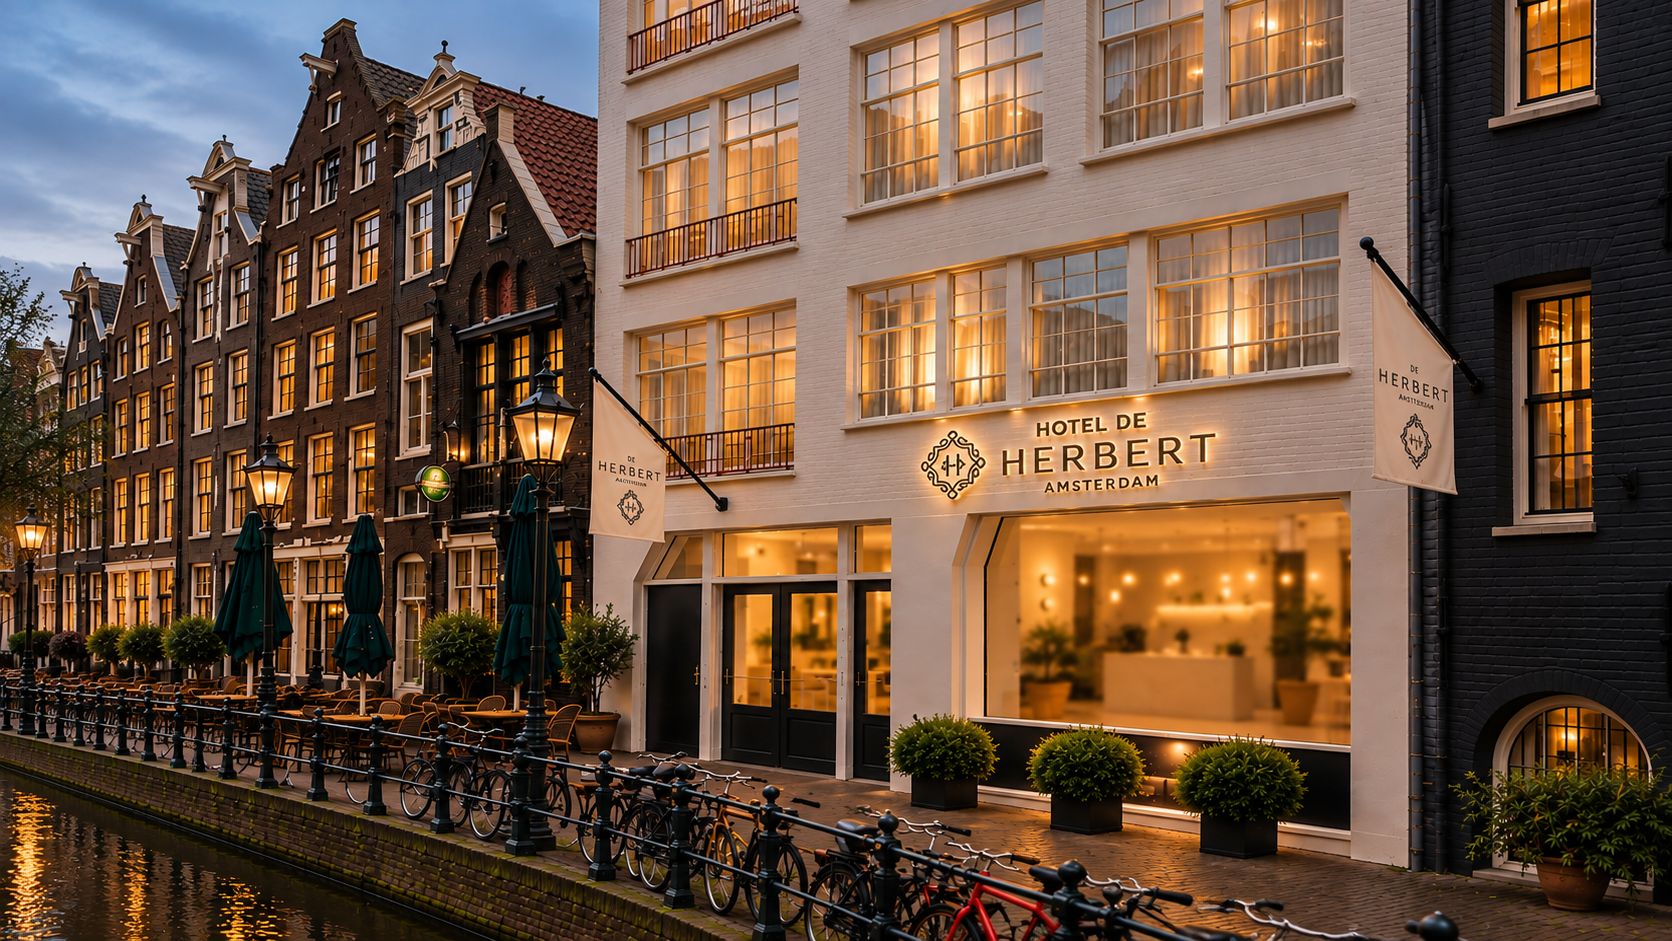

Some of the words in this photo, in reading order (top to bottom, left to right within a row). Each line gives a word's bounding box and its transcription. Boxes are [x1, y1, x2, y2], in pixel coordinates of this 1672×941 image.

[1410, 364, 1418, 374] DE
[1379, 368, 1449, 403] HERBERT
[1036, 417, 1107, 437] HOTEL
[1116, 412, 1147, 430] DE
[627, 455, 635, 463] DE
[1002, 432, 1216, 476] HERBERT
[598, 460, 661, 482] HERBERT
[1044, 474, 1159, 493] AMSTERDAM
